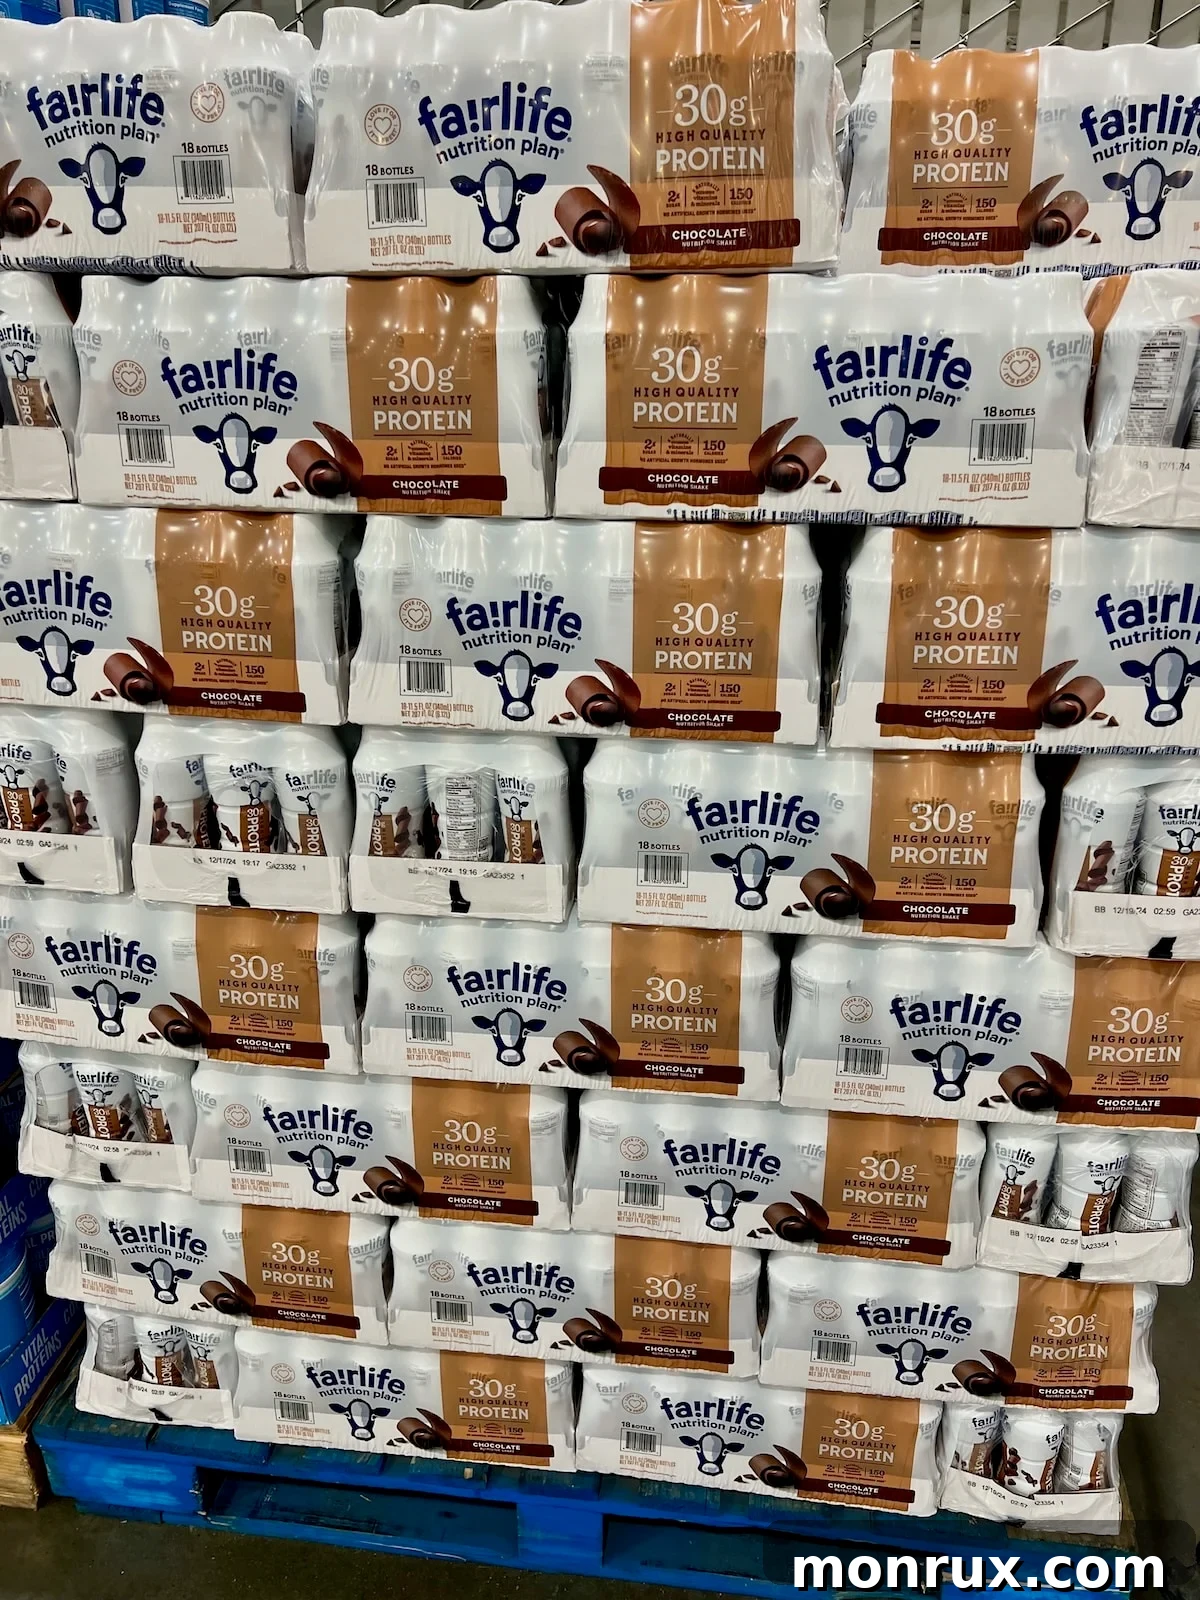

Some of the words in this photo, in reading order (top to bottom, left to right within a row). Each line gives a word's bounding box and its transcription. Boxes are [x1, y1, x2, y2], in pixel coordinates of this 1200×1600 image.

[674, 83, 748, 127] 30g
[45, 122, 115, 148] nutrition
[121, 123, 156, 144] plan
[656, 130, 695, 144] HIGH
[700, 128, 766, 141] QUALITY
[931, 109, 996, 147] 30g
[181, 142, 194, 154] 18
[196, 144, 228, 154] BOTTLES
[437, 135, 515, 164] nutrition
[521, 138, 560, 160] plan
[914, 149, 949, 159] HIGH
[952, 147, 1011, 159] QUALITY
[1093, 136, 1168, 163] nutrition
[1172, 139, 1200, 157] pla
[656, 146, 765, 173] PROTEIN
[366, 165, 378, 176] 18
[381, 166, 414, 175] BOTTLES
[912, 161, 1009, 183] PROTEIN
[729, 188, 753, 200] 150
[672, 228, 747, 241] CHOCOLATE
[923, 231, 988, 242] CHOCOLATE
[651, 345, 722, 384] 30g
[1005, 351, 1020, 364] LOVE
[388, 357, 454, 393] 30g
[373, 395, 407, 405] HIGH
[412, 395, 472, 405] QUALITY
[634, 387, 671, 398] HIGH
[675, 387, 739, 398] QUALITY
[828, 380, 911, 408] nutrition
[915, 387, 957, 407] plan
[178, 392, 248, 416] nutrition
[253, 395, 288, 416] plan
[633, 401, 737, 423] PROTEIN
[984, 406, 997, 417] 18
[1000, 408, 1035, 417] BOTTLES
[117, 412, 128, 422] 18
[129, 414, 160, 422] BOTTLES
[373, 410, 472, 431] PROTEIN
[441, 445, 462, 456] 150
[703, 440, 725, 450] 150
[392, 480, 459, 489] CHOCOLATE
[647, 474, 719, 484] CHOCOLATE
[963, 474, 970, 483] FL
[972, 473, 979, 482] OZ
[1005, 472, 1030, 482] BOTTLES
[1003, 483, 1010, 491] OZ
[193, 585, 255, 619] 30g
[3, 609, 67, 627] nutrition
[72, 613, 103, 631] plan
[672, 602, 739, 636] 30g
[933, 595, 1005, 629] 30g
[182, 630, 272, 652] PROTEIN
[462, 630, 532, 651] nutrition
[537, 633, 570, 653] plan
[656, 637, 690, 647] HIGH
[694, 638, 754, 647] QUALITY
[914, 632, 952, 641] HIGH
[957, 632, 1021, 642] QUALITY
[1109, 626, 1191, 650] nutrition
[400, 645, 411, 655] 18
[413, 648, 442, 656] BOTTLES
[912, 645, 1018, 665] PROTEIN
[655, 651, 752, 670] PROTEIN
[201, 692, 262, 702] CHOCOLATE
[668, 713, 734, 722] CHOCOLATE
[925, 711, 996, 720] CHOCOLATE
[909, 803, 976, 834] 30g
[638, 841, 650, 850] 18
[651, 843, 680, 851] BOTTLES
[700, 826, 769, 844] nutrition
[773, 830, 807, 848] plan
[893, 834, 928, 844] HIGH
[933, 835, 991, 845] QUALITY
[209, 857, 236, 865] 12/17/24
[890, 846, 987, 865] PROTEIN
[902, 905, 969, 915] CHOCOLATE
[229, 954, 285, 982] 30g
[218, 988, 299, 1010] PROTEIN
[644, 977, 704, 1005] 30g
[631, 1014, 717, 1033] PROTEIN
[1107, 1006, 1170, 1035] 30g
[236, 1038, 291, 1050] CHOCOLATE
[1087, 1045, 1181, 1064] PROTEIN
[644, 1064, 704, 1075] CHOCOLATE
[1096, 1099, 1161, 1108] CHOCOLATE
[444, 1120, 497, 1144] 30g
[432, 1152, 512, 1170] PROTEIN
[858, 1156, 917, 1183] 30g
[448, 1196, 502, 1207] CHOCOLATE
[842, 1189, 927, 1209] PROTEIN
[852, 1233, 910, 1245] CHOCOLATE
[1026, 1233, 1054, 1243] 12/19/24
[271, 1241, 320, 1265] 30g
[262, 1269, 334, 1290] PROTEIN
[645, 1276, 697, 1301] 30g
[277, 1309, 326, 1321] CHOCOLATE
[632, 1305, 709, 1323] PROTEIN
[1046, 1313, 1097, 1338] 30g
[21, 1327, 49, 1368] VITAL
[644, 1345, 697, 1356] CHOCOLATE
[1029, 1343, 1108, 1360] PROTEIN
[13, 1329, 62, 1407] PROTEINS
[468, 1378, 517, 1400] 30g
[1037, 1387, 1094, 1397] CHOCOLATE
[458, 1404, 529, 1421] PROTEIN
[832, 1418, 886, 1441] 30g
[472, 1442, 521, 1451] CHOCOLATE
[818, 1443, 895, 1464] PROTEIN
[827, 1482, 879, 1494] CHOCOLATE
